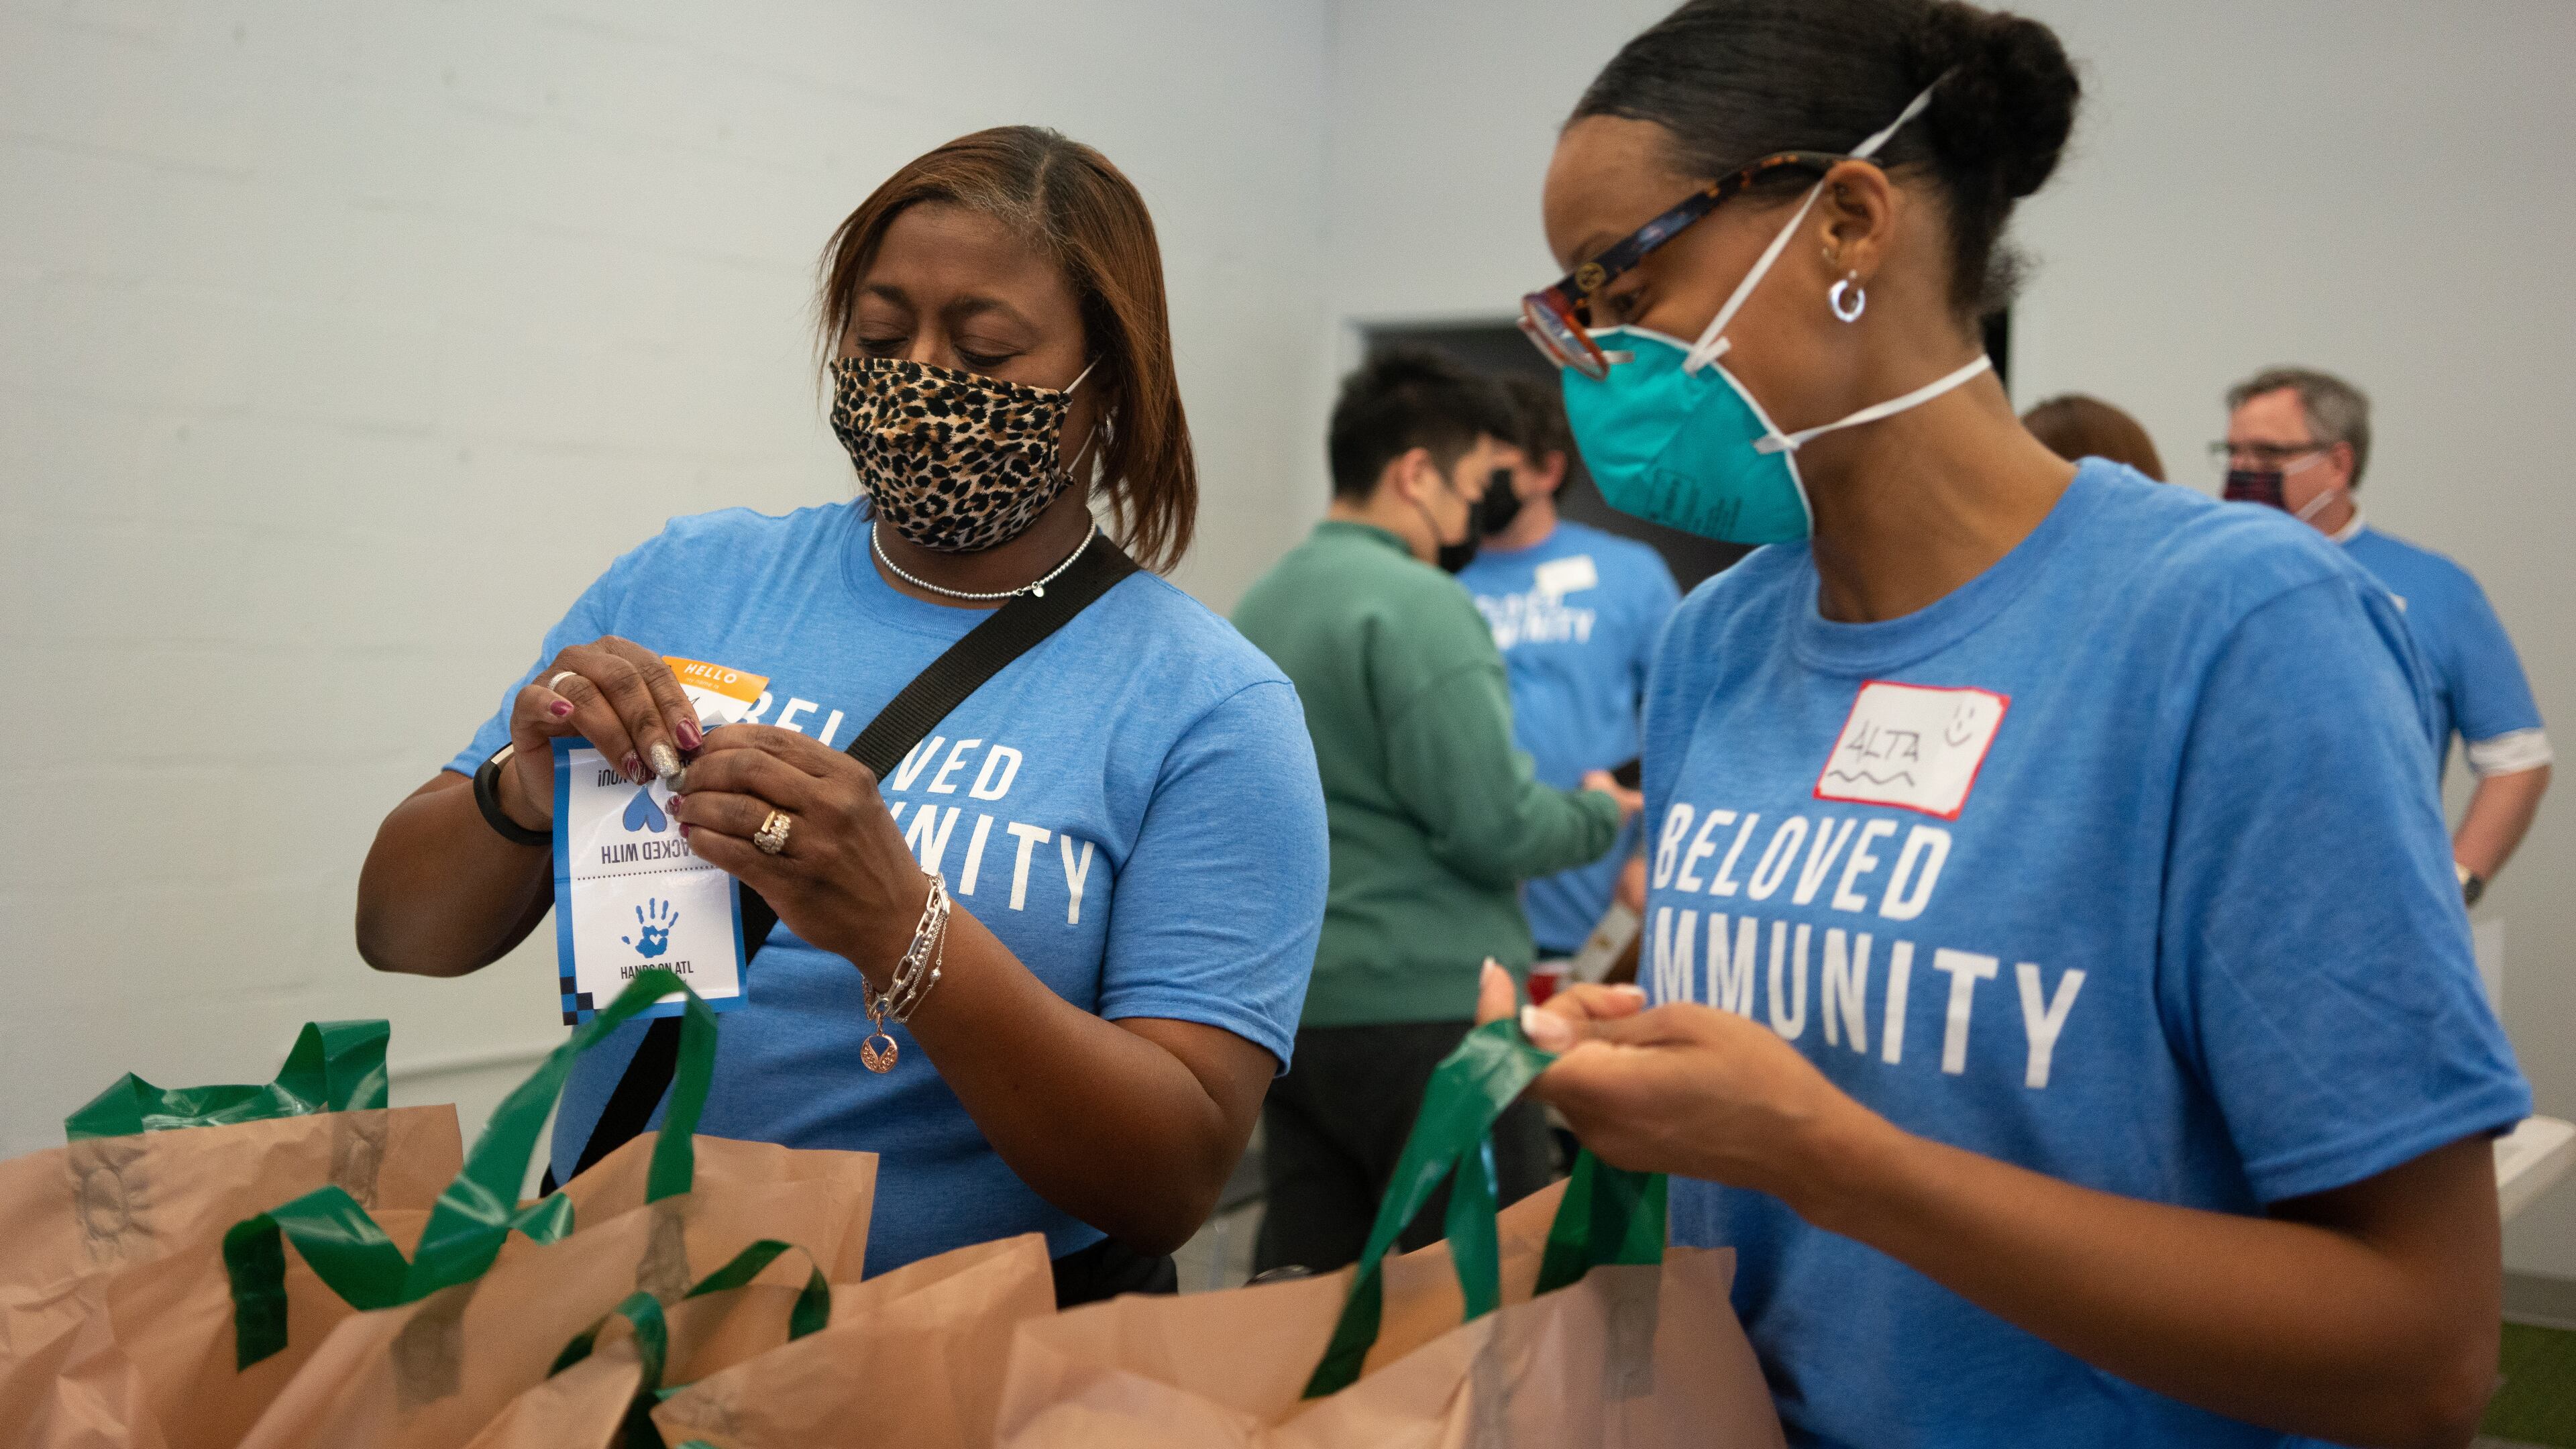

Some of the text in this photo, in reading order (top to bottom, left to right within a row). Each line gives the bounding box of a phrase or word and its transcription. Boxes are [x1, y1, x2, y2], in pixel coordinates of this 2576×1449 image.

[684, 663, 737, 684] HELLO
[601, 837, 692, 865] ACKED WITH
[884, 800, 1095, 925] NITY
[1652, 802, 1953, 921] BELOVED
[675, 961, 694, 974] ATL
[1652, 906, 2087, 1090] MMUNITY
